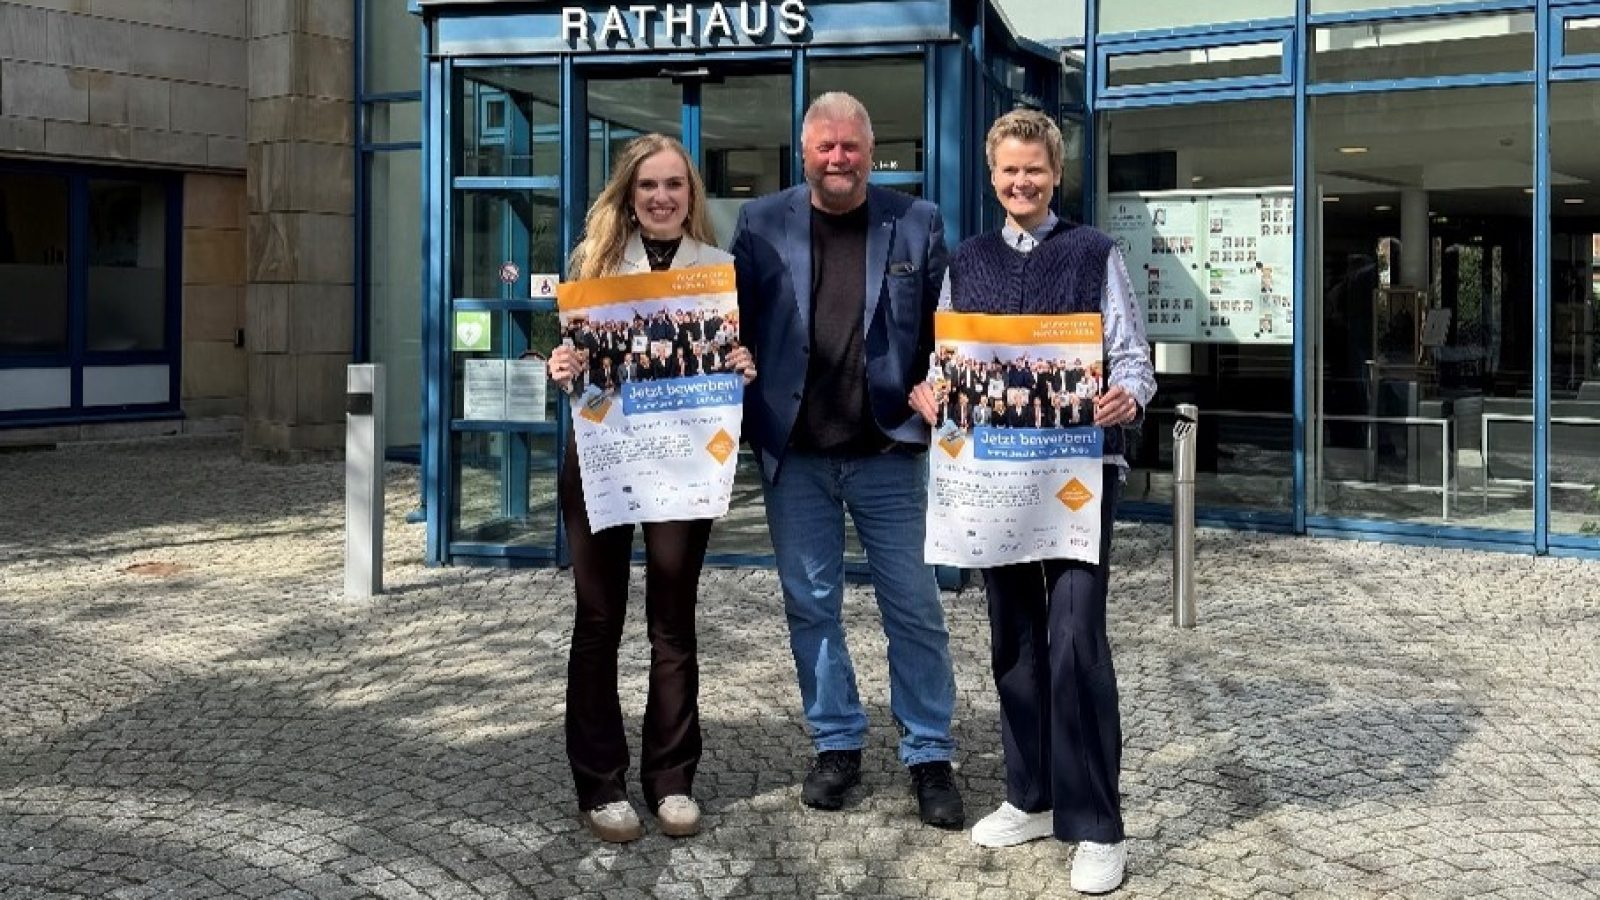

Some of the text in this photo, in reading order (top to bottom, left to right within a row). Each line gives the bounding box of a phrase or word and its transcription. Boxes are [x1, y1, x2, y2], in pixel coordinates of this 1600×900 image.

[562, 0, 806, 40] RATHAUS
[630, 379, 738, 399] Jetzt bewerben!
[981, 431, 1096, 445] Jetzt bewerben!
